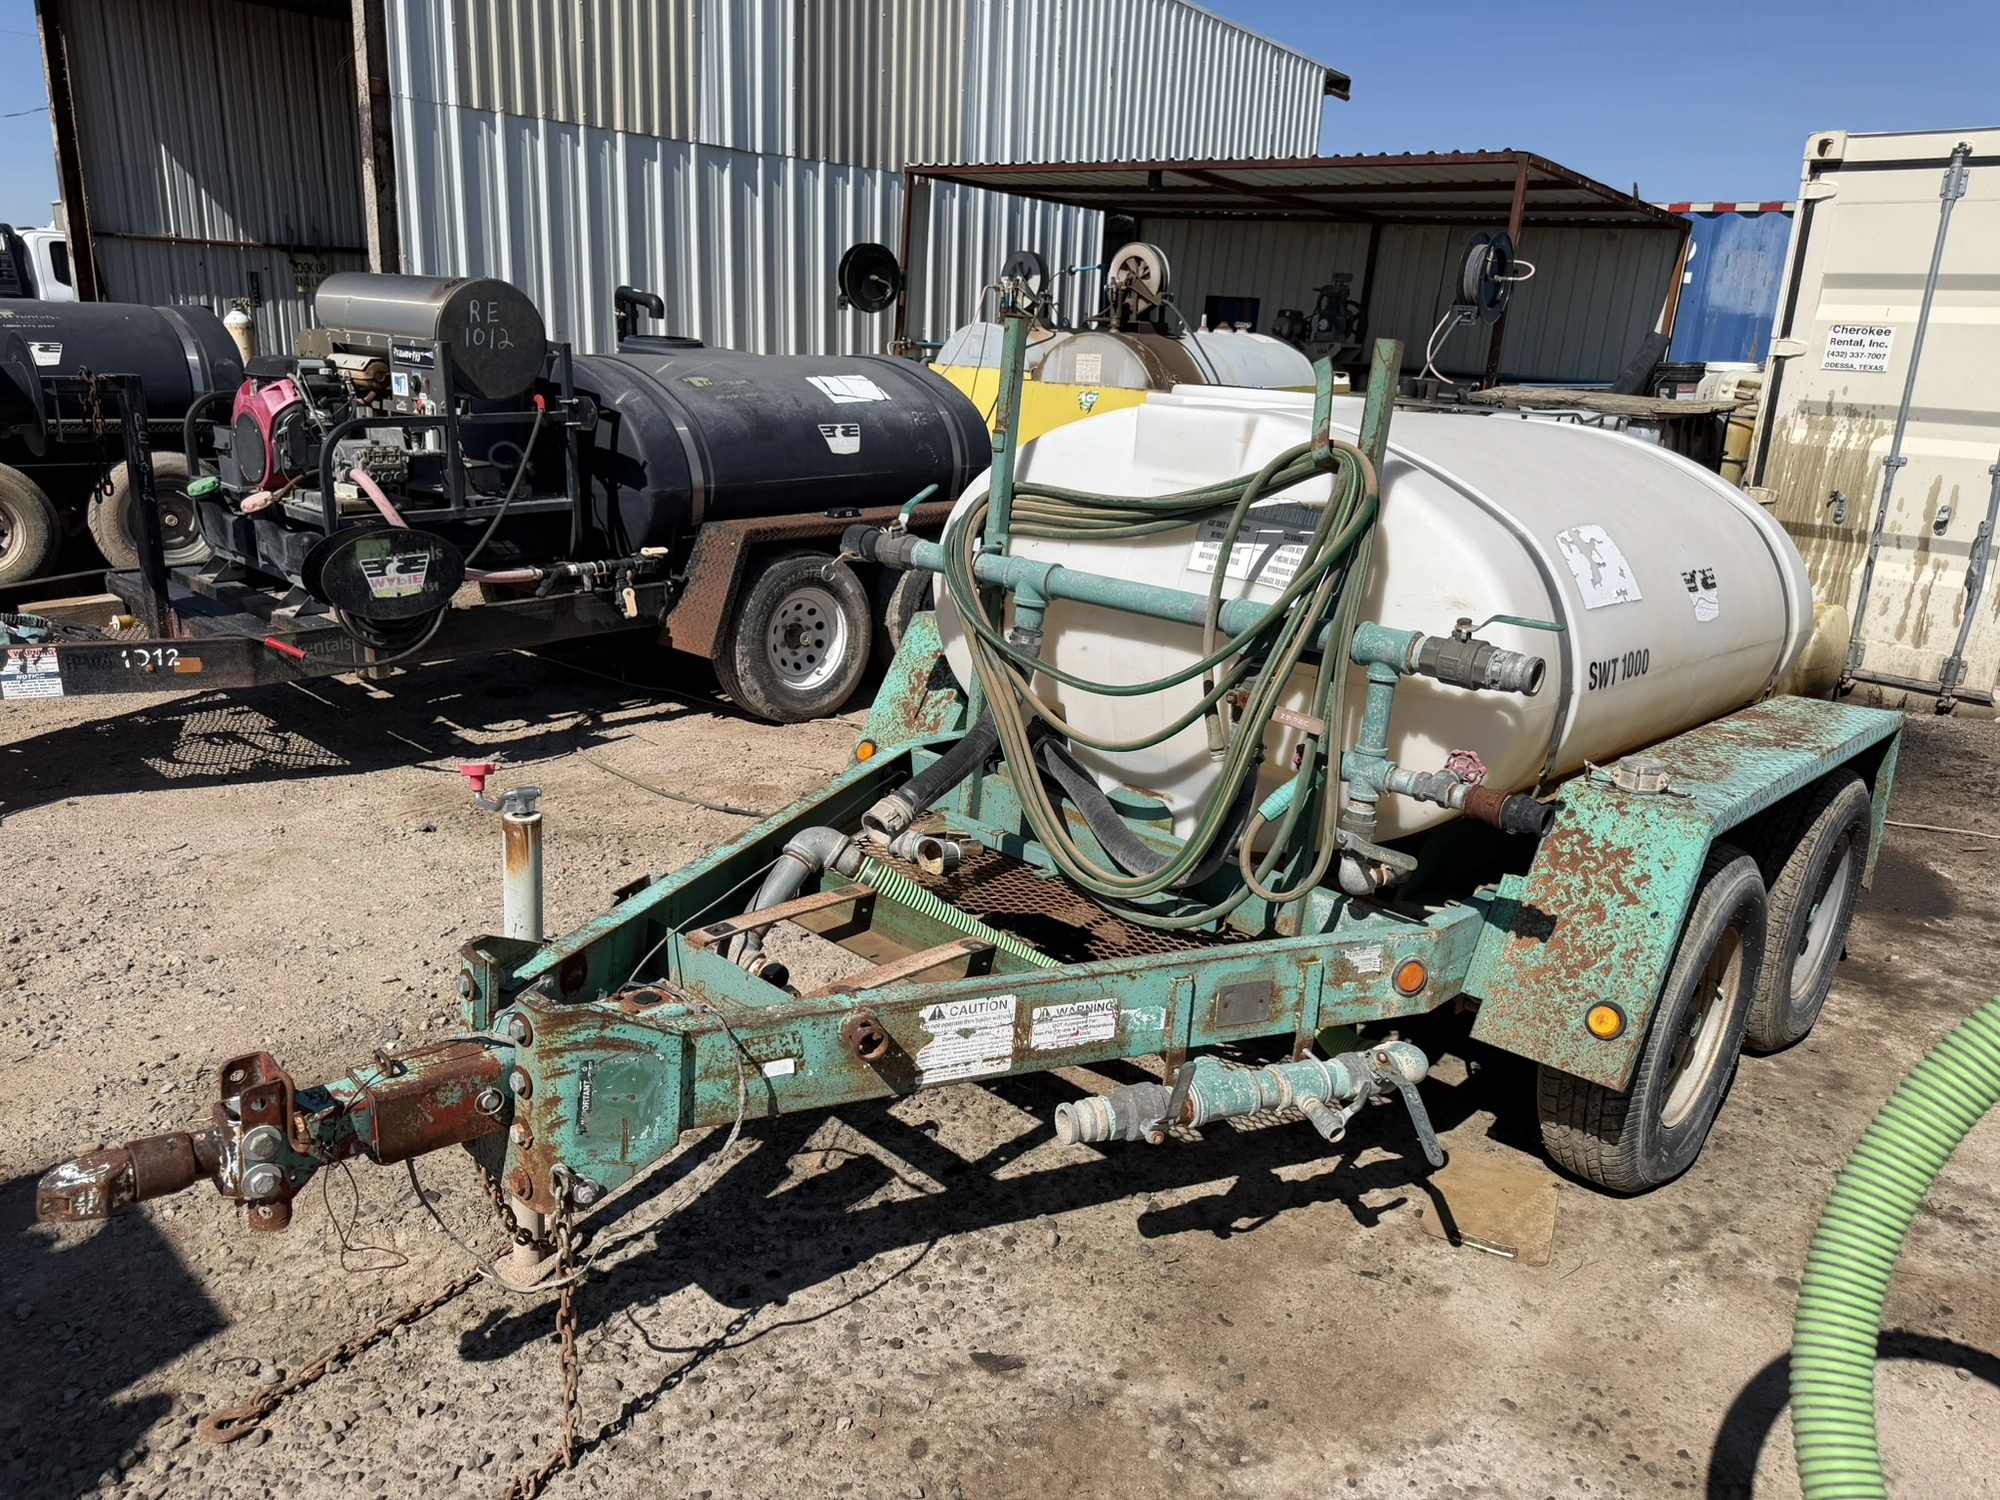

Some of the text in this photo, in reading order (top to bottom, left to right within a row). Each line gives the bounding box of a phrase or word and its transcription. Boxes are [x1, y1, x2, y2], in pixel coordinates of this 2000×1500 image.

[316, 261, 326, 274] UP
[1832, 324, 1892, 337] Cherokee
[465, 327, 515, 350] 1012
[1829, 337, 1888, 349] Rental, Inc.
[1826, 349, 1887, 360] (432) 337-7007
[1858, 363, 1884, 371] TEXAS
[370, 573, 424, 589] WYLIE
[1588, 648, 1650, 691] SWT 1000
[949, 999, 1008, 1017] CAUTION
[941, 1020, 963, 1028] operate
